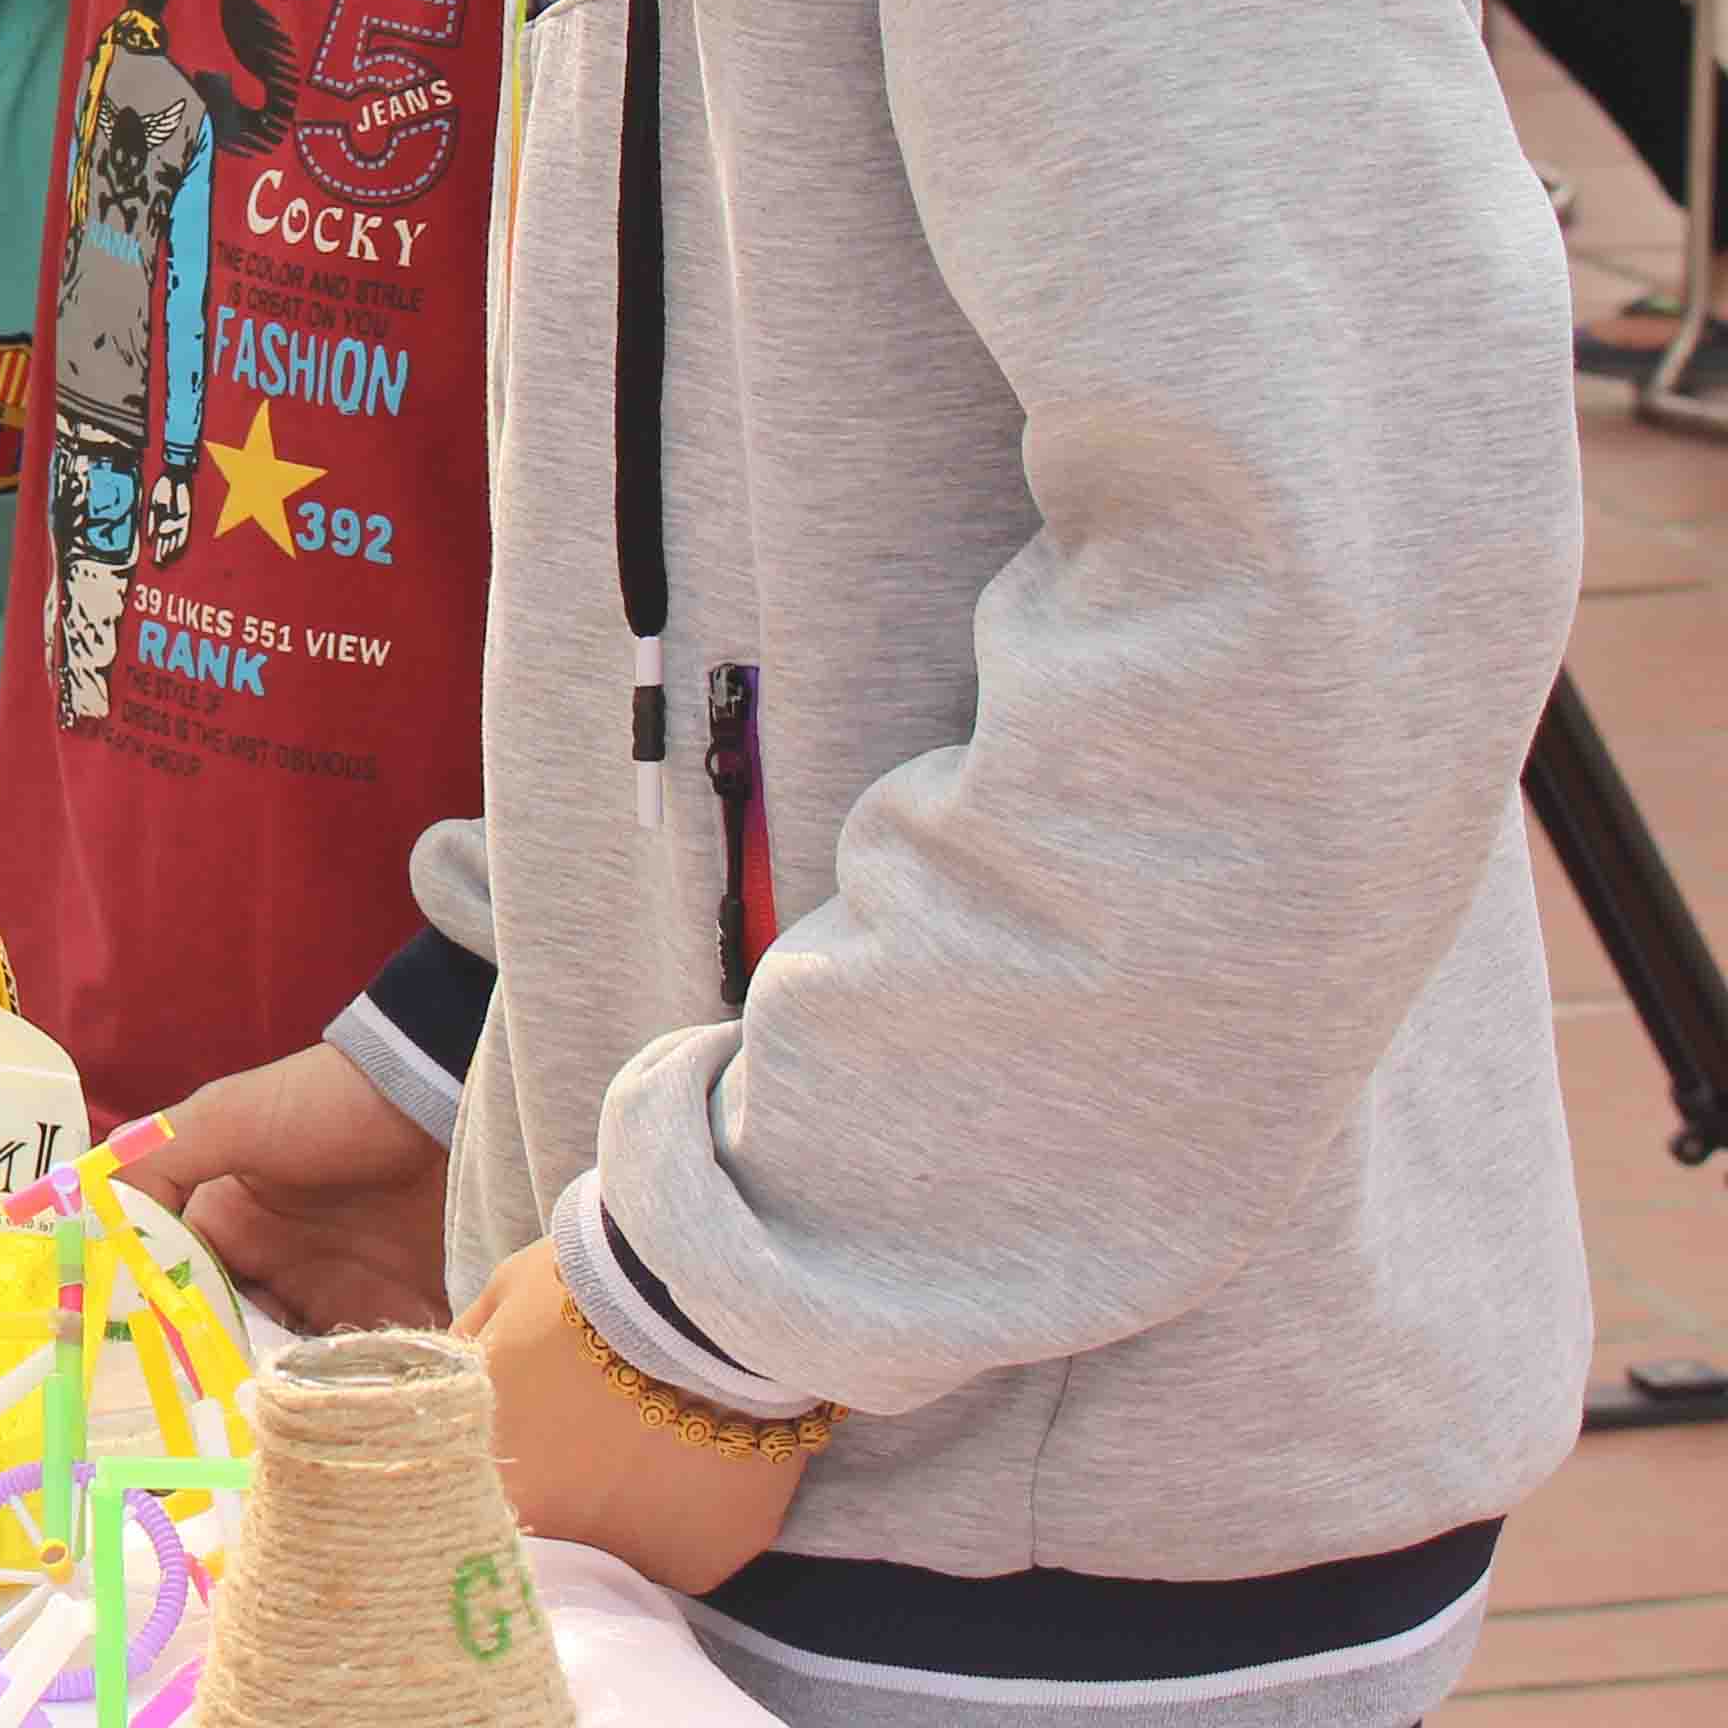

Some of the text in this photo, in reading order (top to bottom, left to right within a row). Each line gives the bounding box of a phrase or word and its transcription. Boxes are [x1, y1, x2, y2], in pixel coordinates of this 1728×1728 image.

[356, 79, 454, 133] JEANS
[213, 305, 409, 416] FASHION
[294, 501, 394, 567] 392
[134, 584, 391, 668] 39 LIKES 551 VIEW
[137, 619, 268, 697] RANK
